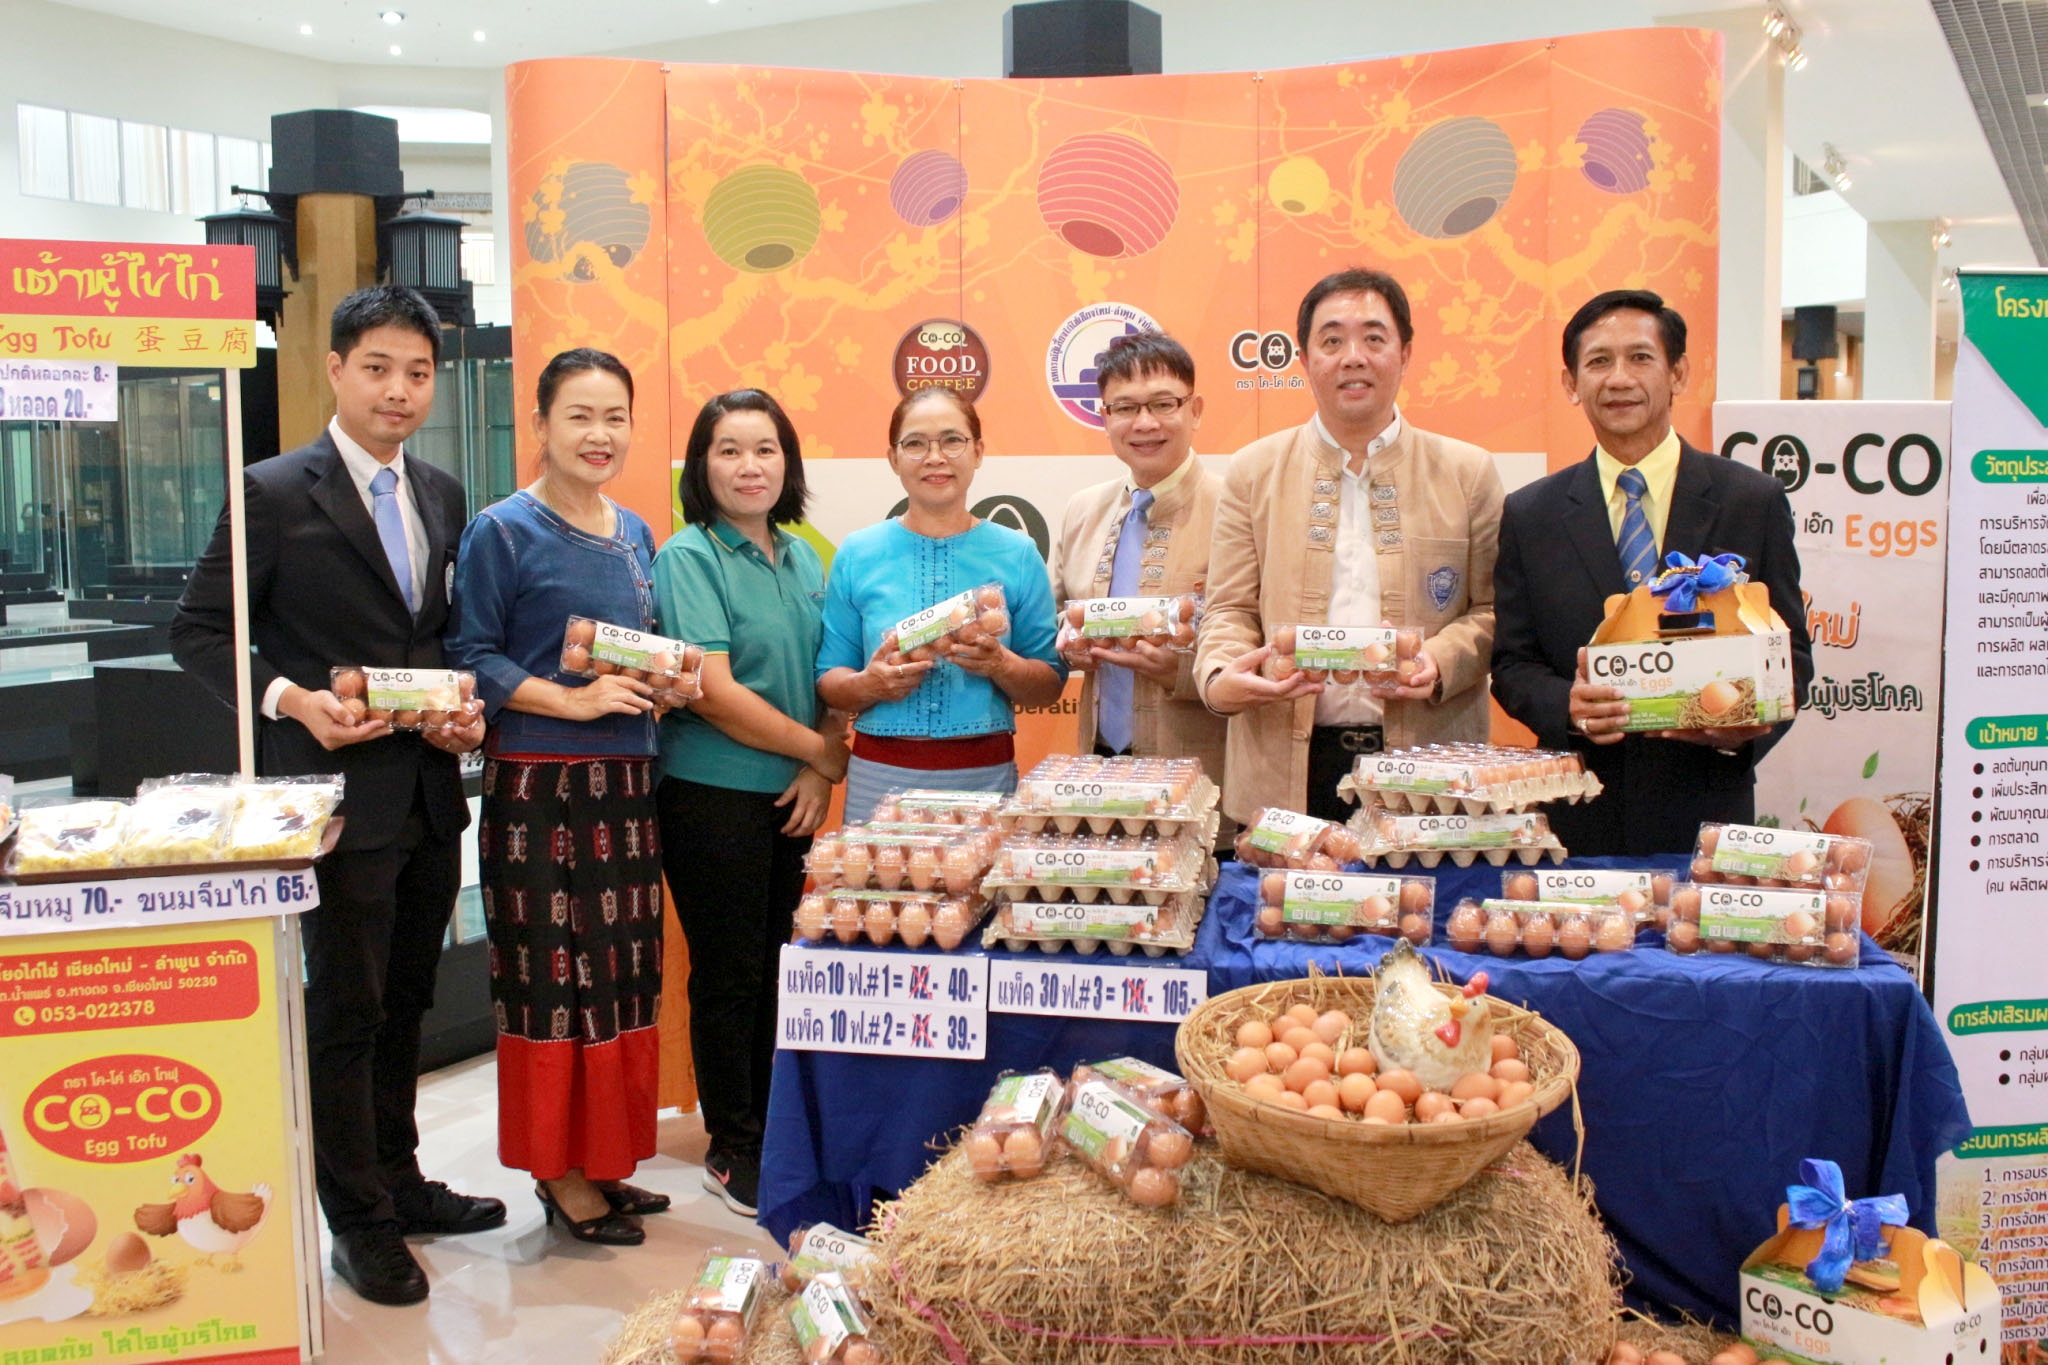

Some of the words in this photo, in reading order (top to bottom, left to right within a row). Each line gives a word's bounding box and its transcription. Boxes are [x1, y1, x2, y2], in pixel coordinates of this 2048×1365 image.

[53, 326, 112, 352] Tofu
[920, 331, 962, 344] CO-CO
[906, 355, 976, 374] FOOD
[9, 395, 58, 418] หลอด
[1985, 455, 2048, 482] วัตถุประ
[2026, 486, 2048, 505] เพื่อ
[1980, 514, 2048, 530] การบริหารจั
[1845, 514, 1938, 558] Eggs
[1980, 537, 2048, 554] โดยมีตลาดร
[1979, 563, 2048, 579] สามารถลดต้
[1090, 601, 1127, 613] CO-CO
[901, 608, 934, 631] CO-CO
[602, 626, 641, 643] CO-CO
[1303, 629, 1346, 641] CO-CO
[1977, 638, 2024, 653] การผลิต
[2029, 640, 2048, 651] ผล
[1594, 651, 1674, 677] CO-CO
[1977, 657, 2048, 677] และการตลาด
[372, 672, 413, 683] CO-CO
[1979, 722, 2038, 744] เป้าหมาย
[1377, 761, 1415, 775] CO-CO
[1054, 783, 1102, 796] CO-CO
[1419, 817, 1467, 831] CO-CO
[1990, 807, 2048, 825] พัฒนาคุณ
[1728, 829, 1775, 845] CO-CO
[1989, 832, 2039, 846] การตลาด
[1035, 852, 1085, 865] CO-CO
[1294, 877, 1343, 892] CO-CO
[1546, 876, 1595, 889] CO-CO
[81, 886, 122, 915] 70.-
[138, 878, 266, 913] ขนมจีบไก่
[276, 875, 314, 904] 65.-
[1710, 892, 1764, 907] CO-CO
[1036, 906, 1086, 919] CO-CO
[178, 976, 218, 989] 50230
[948, 967, 978, 1002] 40.-
[1040, 973, 1059, 1008] 30
[1162, 979, 1197, 1016] 105.-
[41, 1000, 156, 1023] 053-022378
[830, 1009, 847, 1043] 10
[947, 1015, 977, 1051] 39.-
[33, 1084, 212, 1132] CO-CO
[1081, 1092, 1110, 1119] CO-CO
[85, 1139, 119, 1156] Egg
[127, 1133, 168, 1150] Tofu
[1984, 1168, 1996, 1182] 1.
[809, 1234, 845, 1255] CO-CO
[1746, 1287, 1834, 1336] CO-CO
[1953, 1315, 1982, 1335] CO-CO
